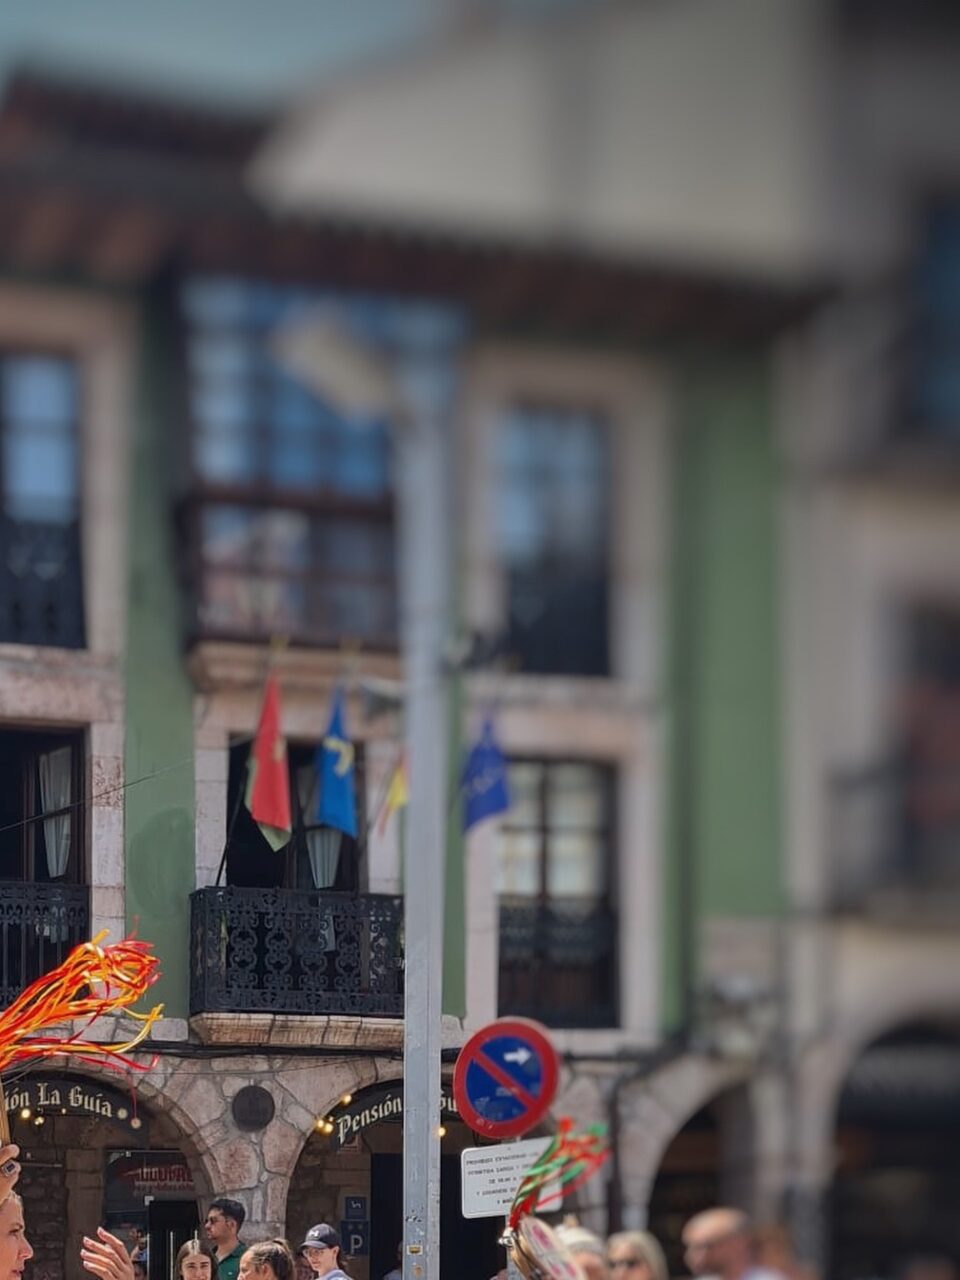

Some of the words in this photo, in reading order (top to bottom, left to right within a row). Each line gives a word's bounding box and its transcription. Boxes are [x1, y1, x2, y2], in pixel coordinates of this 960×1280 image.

[36, 1082, 61, 1106] La
[68, 1085, 113, 1118] Guía
[336, 1093, 403, 1145] Pensión
